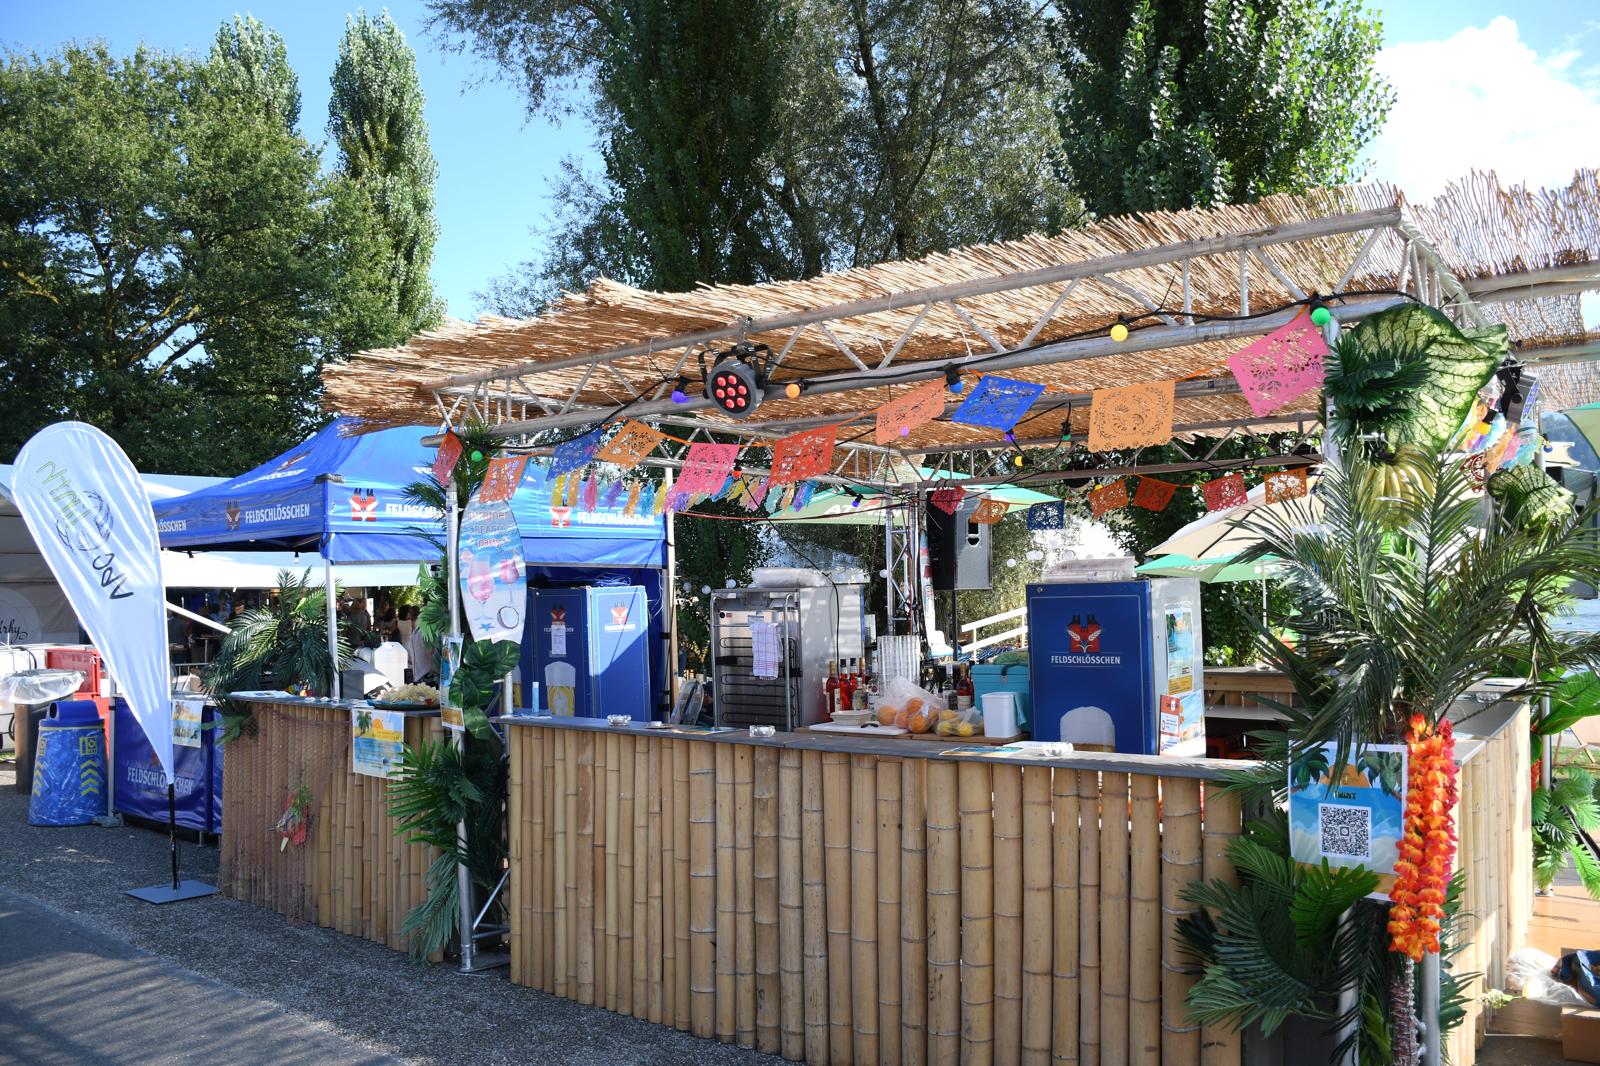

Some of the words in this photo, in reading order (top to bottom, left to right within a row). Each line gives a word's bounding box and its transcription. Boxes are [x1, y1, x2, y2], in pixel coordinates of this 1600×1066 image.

[245, 504, 310, 524] FELDSCHLÖSSCHEN
[474, 525, 504, 534] BEACH
[477, 538, 500, 549] party
[1051, 653, 1120, 665] FELDSCHLÖSSCHEN
[127, 767, 194, 794] FELDSCHLÖCHEN
